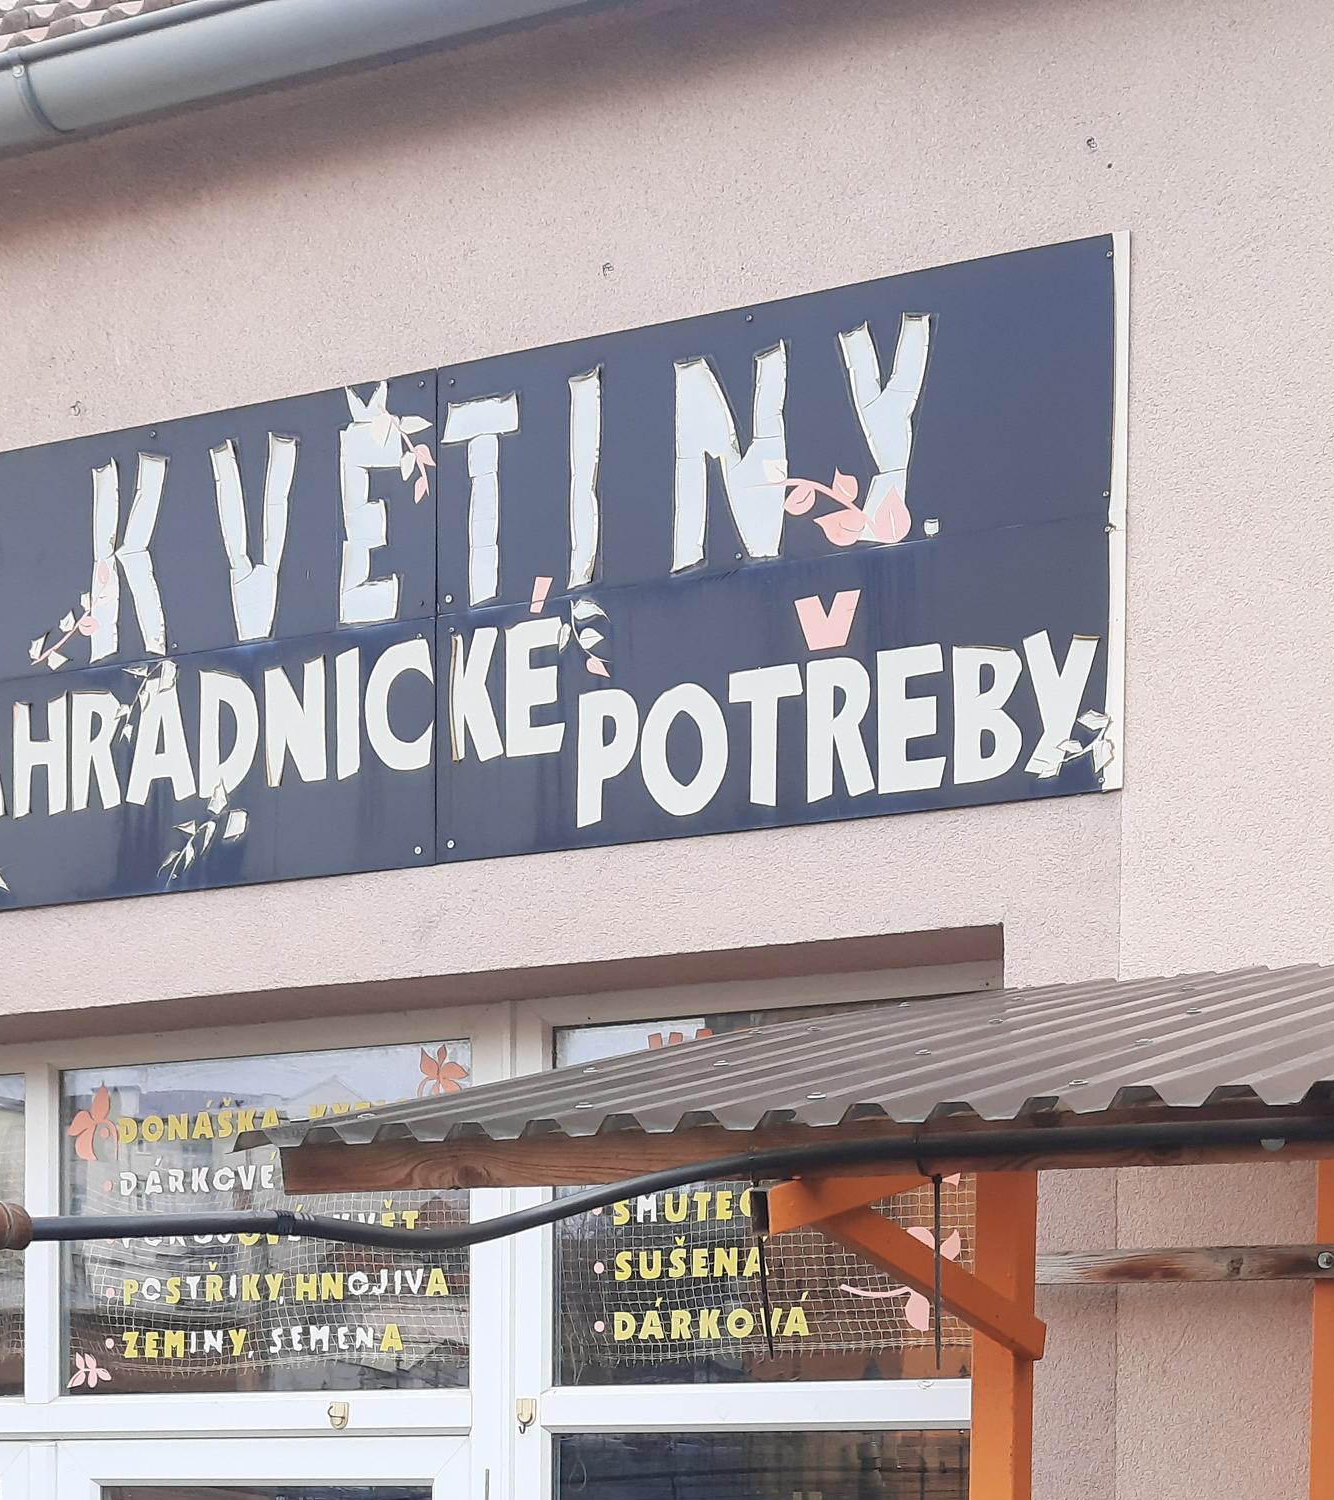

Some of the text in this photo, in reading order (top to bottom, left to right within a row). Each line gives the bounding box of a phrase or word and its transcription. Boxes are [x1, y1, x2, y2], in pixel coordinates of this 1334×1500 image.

[91, 312, 933, 660] KVĚTINY
[577, 590, 1102, 828] POTŘEBY
[119, 1098, 280, 1144] DONÁŠKA
[119, 1152, 277, 1195] DÁRKOVÉ
[295, 1267, 450, 1301] HNOJIVA
[614, 1291, 811, 1341] DÁRKOVÁ
[122, 1323, 404, 1358] ZEMINY, SEMENA
